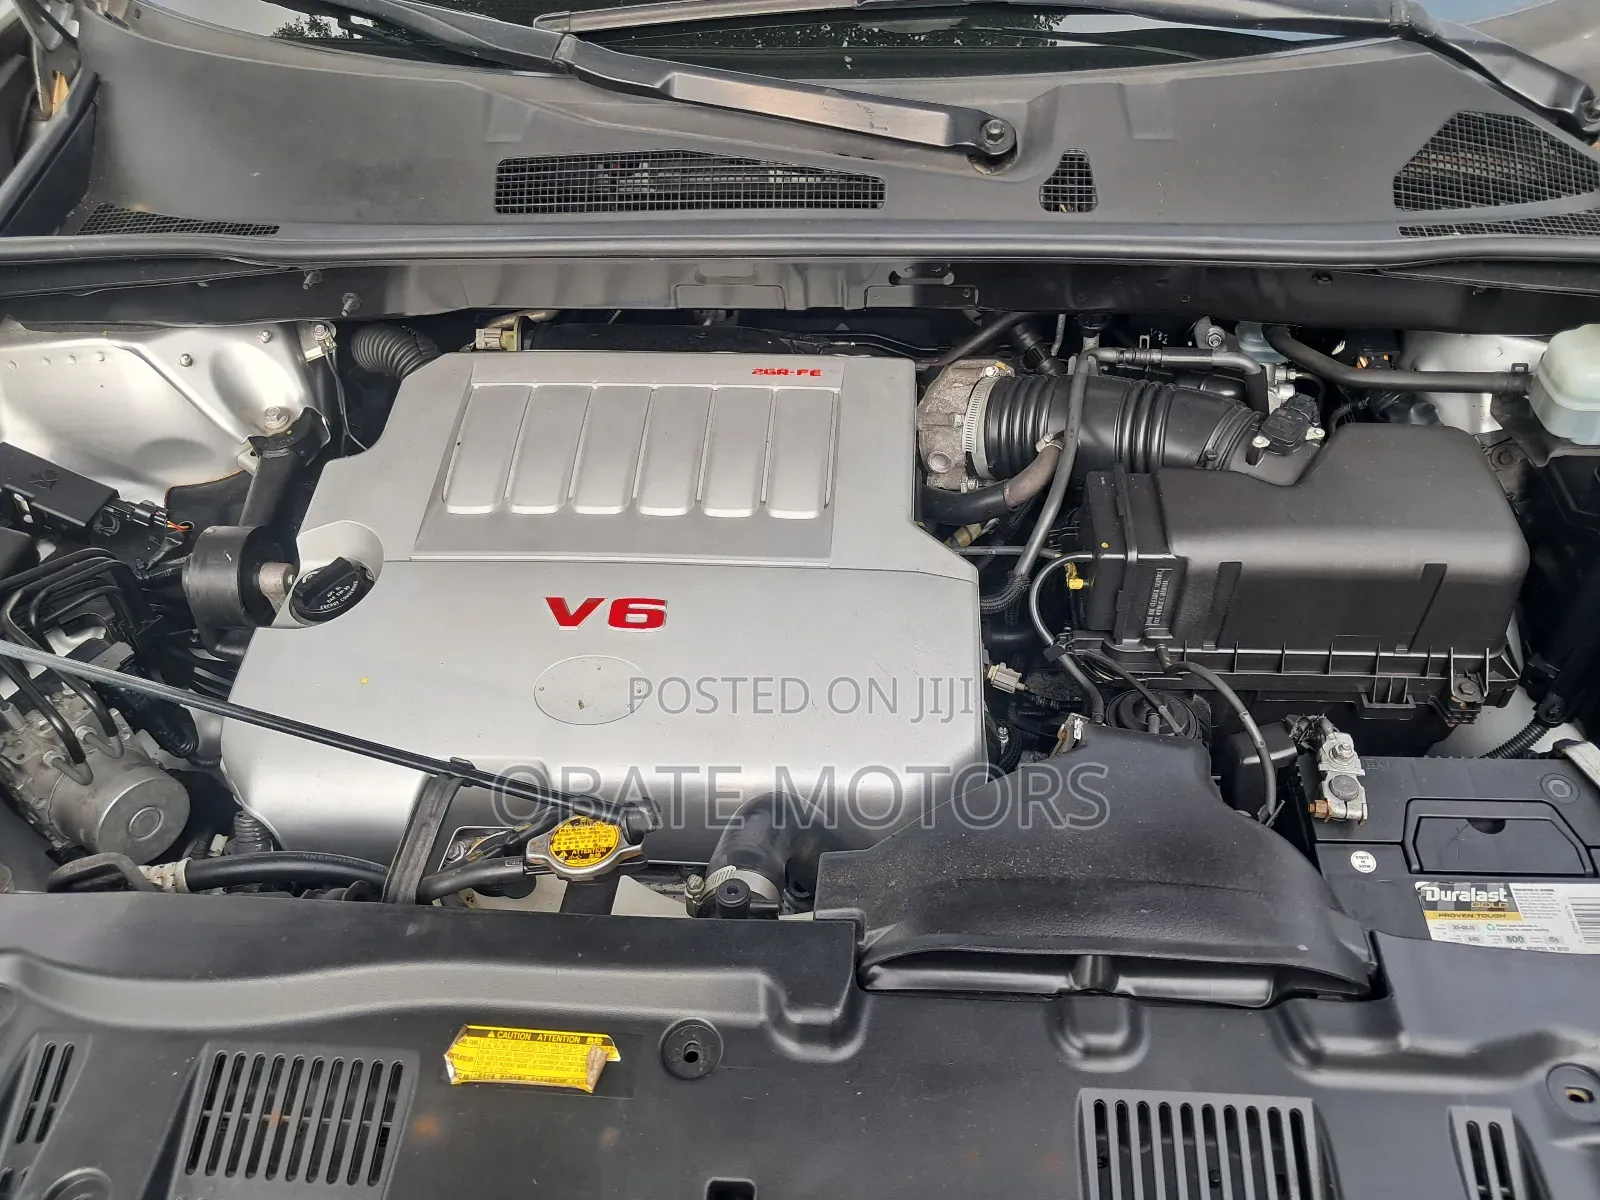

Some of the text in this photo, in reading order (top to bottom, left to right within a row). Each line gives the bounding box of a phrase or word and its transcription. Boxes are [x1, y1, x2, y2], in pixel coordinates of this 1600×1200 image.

[752, 368, 822, 377] 2GR-FE
[545, 596, 668, 632] V6
[1422, 887, 1508, 902] Duralast
[1506, 935, 1525, 944] 800
[497, 1031, 532, 1041] CAUTION
[537, 1034, 581, 1044] ATTENTION
